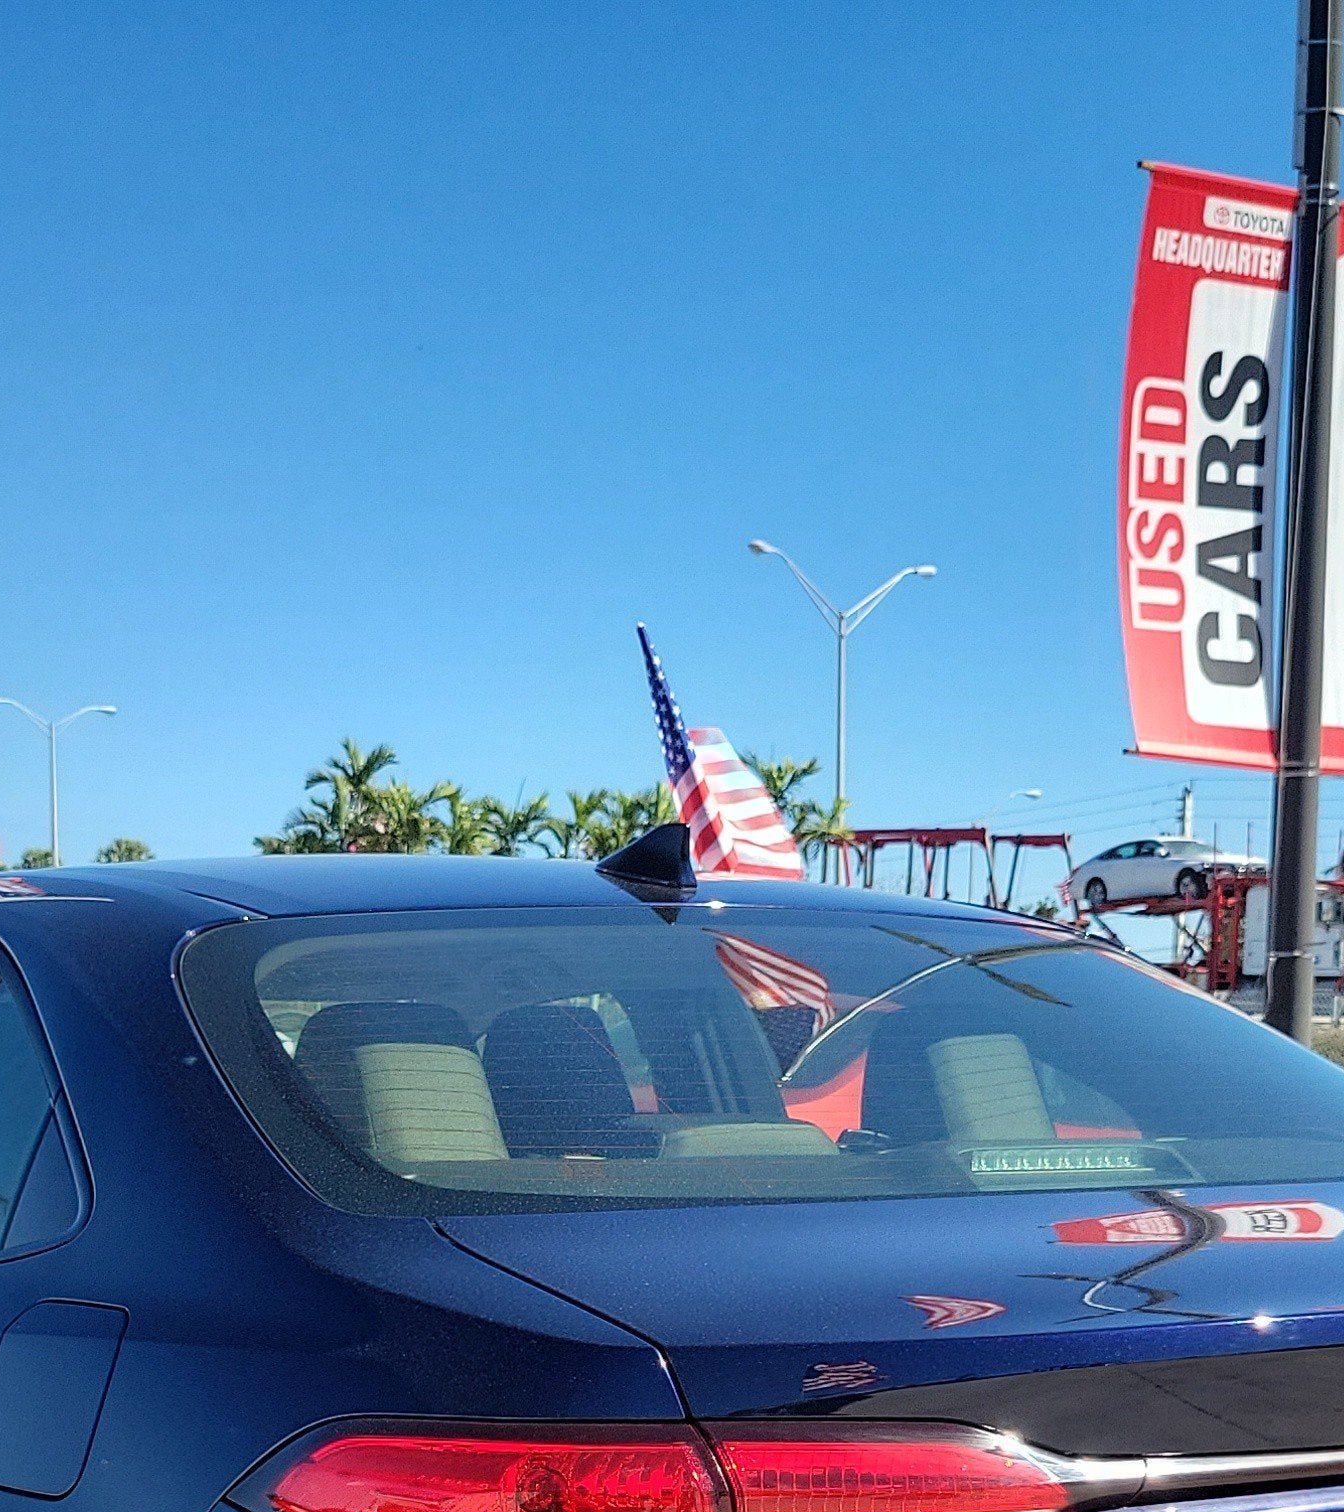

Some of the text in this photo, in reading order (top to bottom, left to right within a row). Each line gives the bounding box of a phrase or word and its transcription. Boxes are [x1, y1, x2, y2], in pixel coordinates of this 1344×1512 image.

[1152, 227, 1286, 281] HEADQUARTER
[1232, 210, 1284, 236] TOYOTA
[1131, 383, 1187, 627] USED
[1196, 349, 1269, 689] CARS
